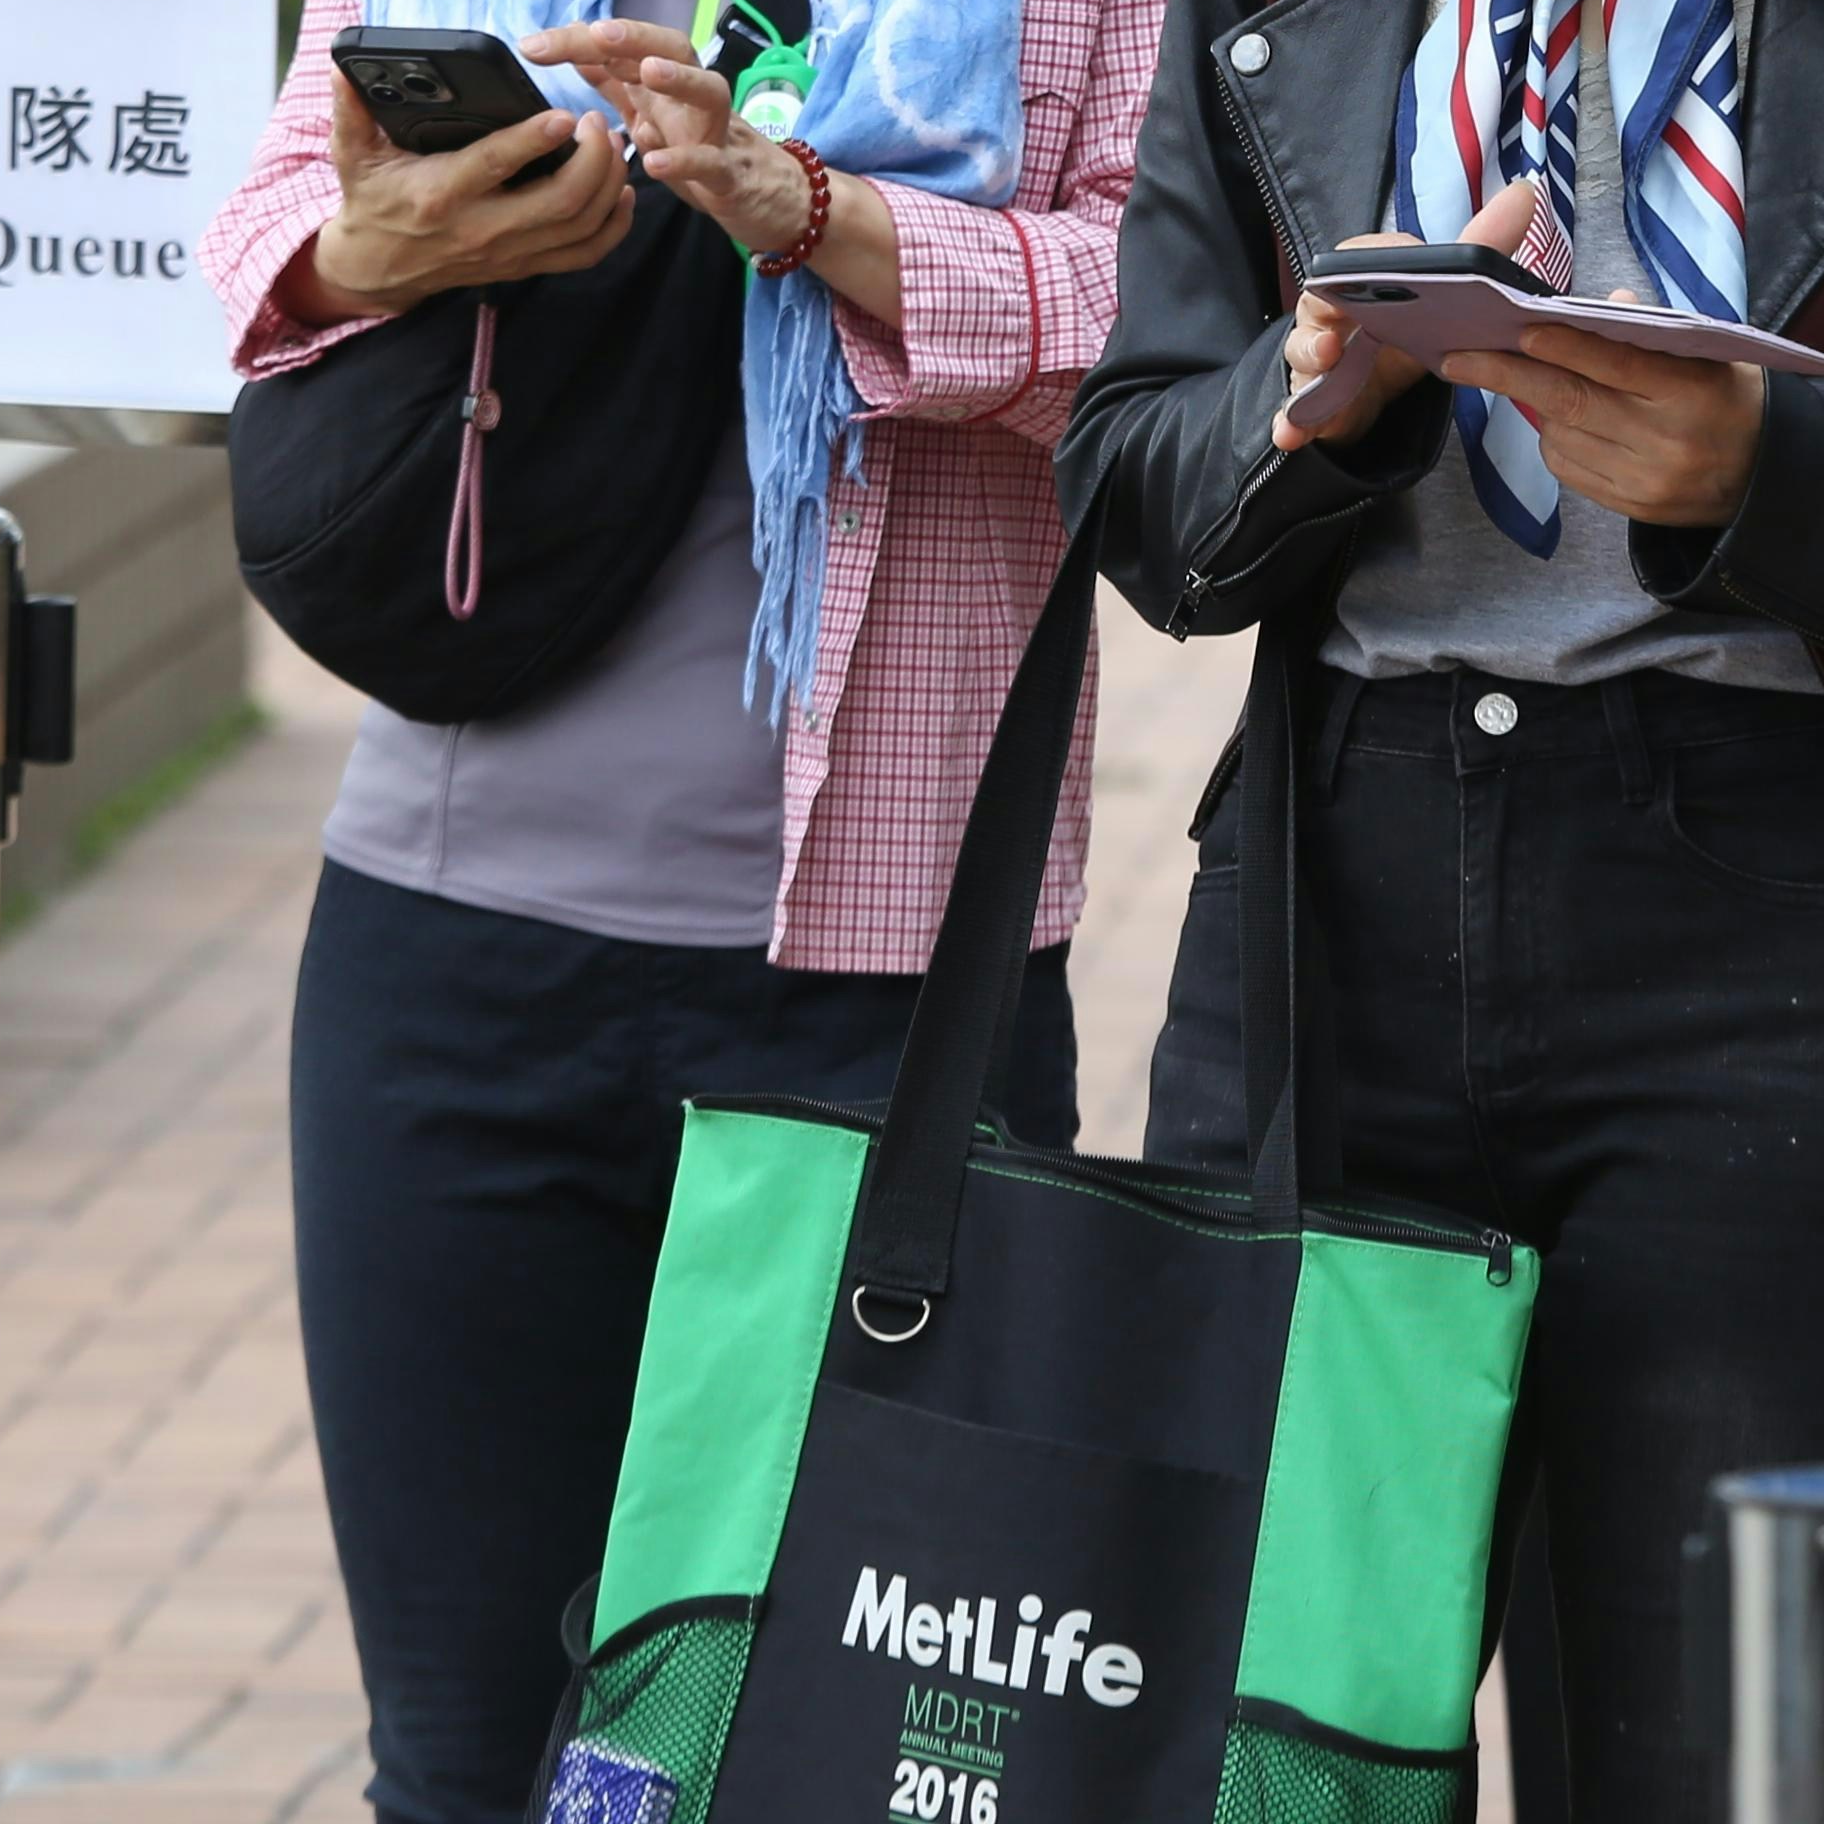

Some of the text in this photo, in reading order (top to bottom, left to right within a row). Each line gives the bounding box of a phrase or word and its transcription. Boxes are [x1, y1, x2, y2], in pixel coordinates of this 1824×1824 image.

[841, 1565, 1144, 1707] MetLife
[899, 1728, 1005, 1769] ANNUAL MEETING
[888, 1757, 999, 1824] 2016
